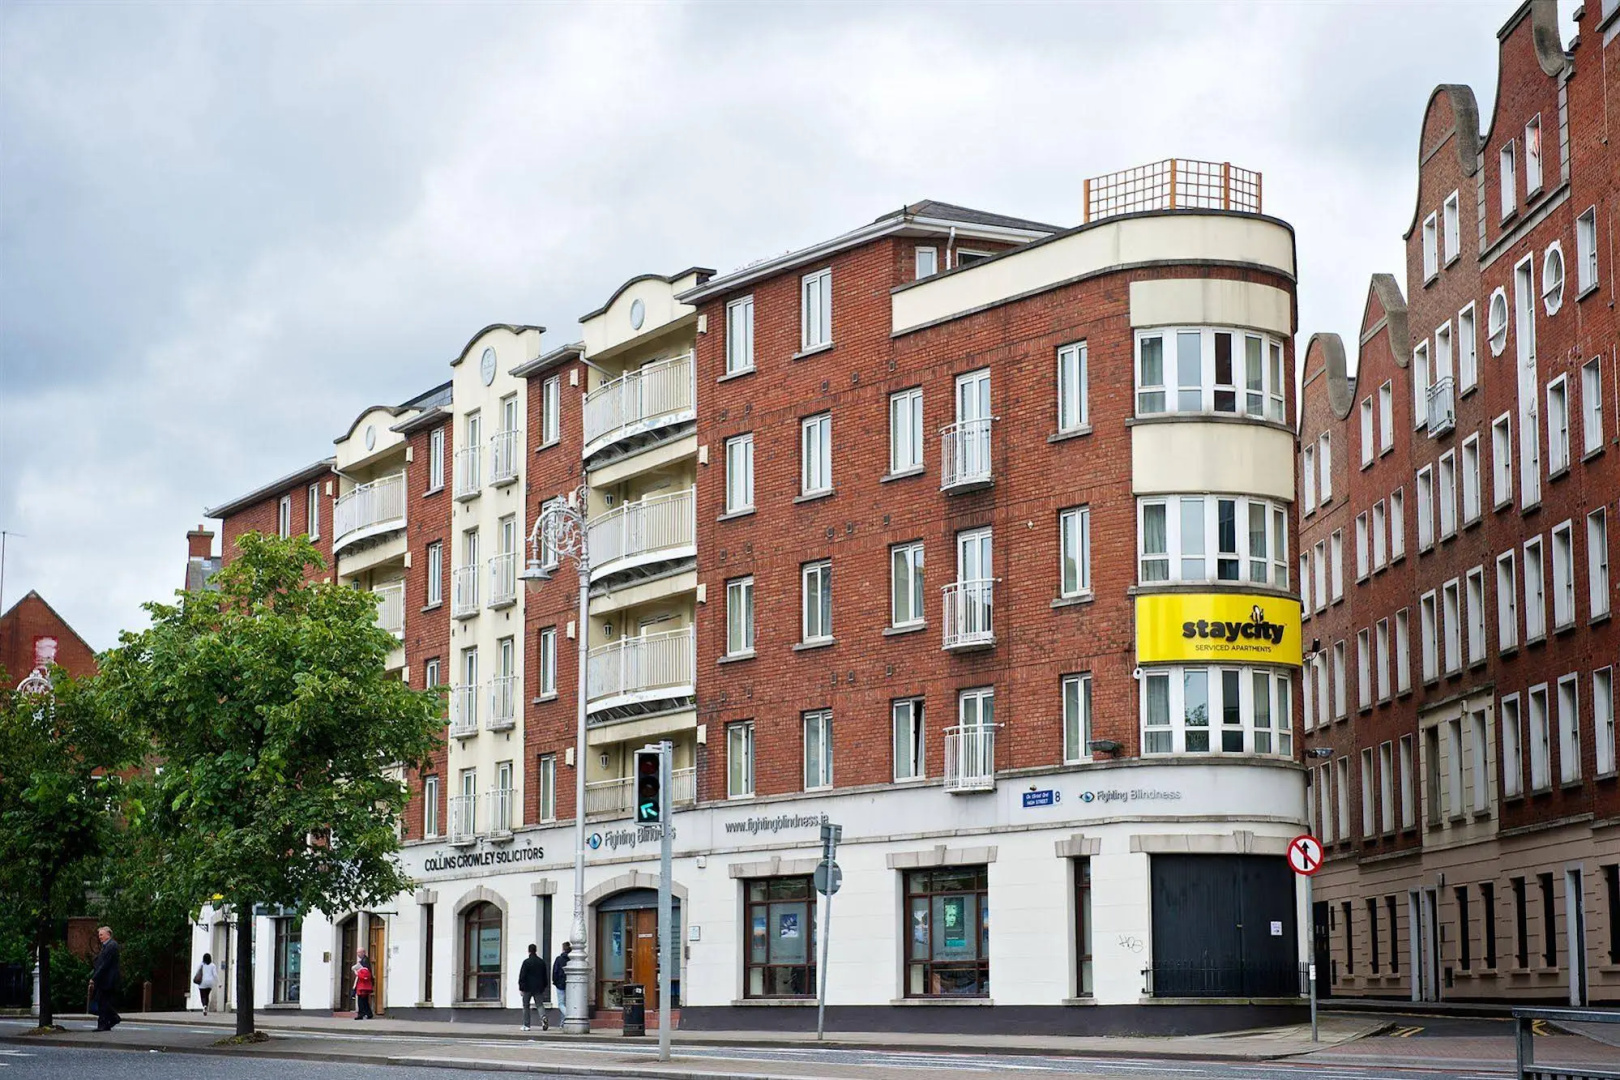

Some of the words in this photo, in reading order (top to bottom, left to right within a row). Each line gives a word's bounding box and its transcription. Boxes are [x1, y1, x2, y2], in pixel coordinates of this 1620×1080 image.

[1182, 619, 1285, 645] staycity
[1195, 644, 1230, 652] SERVICED
[1231, 645, 1272, 653] APARTMENTS
[1055, 791, 1061, 803] 8
[1097, 790, 1129, 803] Fighting
[1130, 789, 1182, 801] Blindness
[604, 829, 636, 850] Fighting
[424, 857, 457, 872] COLLINS
[456, 851, 496, 869] CROWLEY
[496, 846, 544, 864] SOLICITORS
